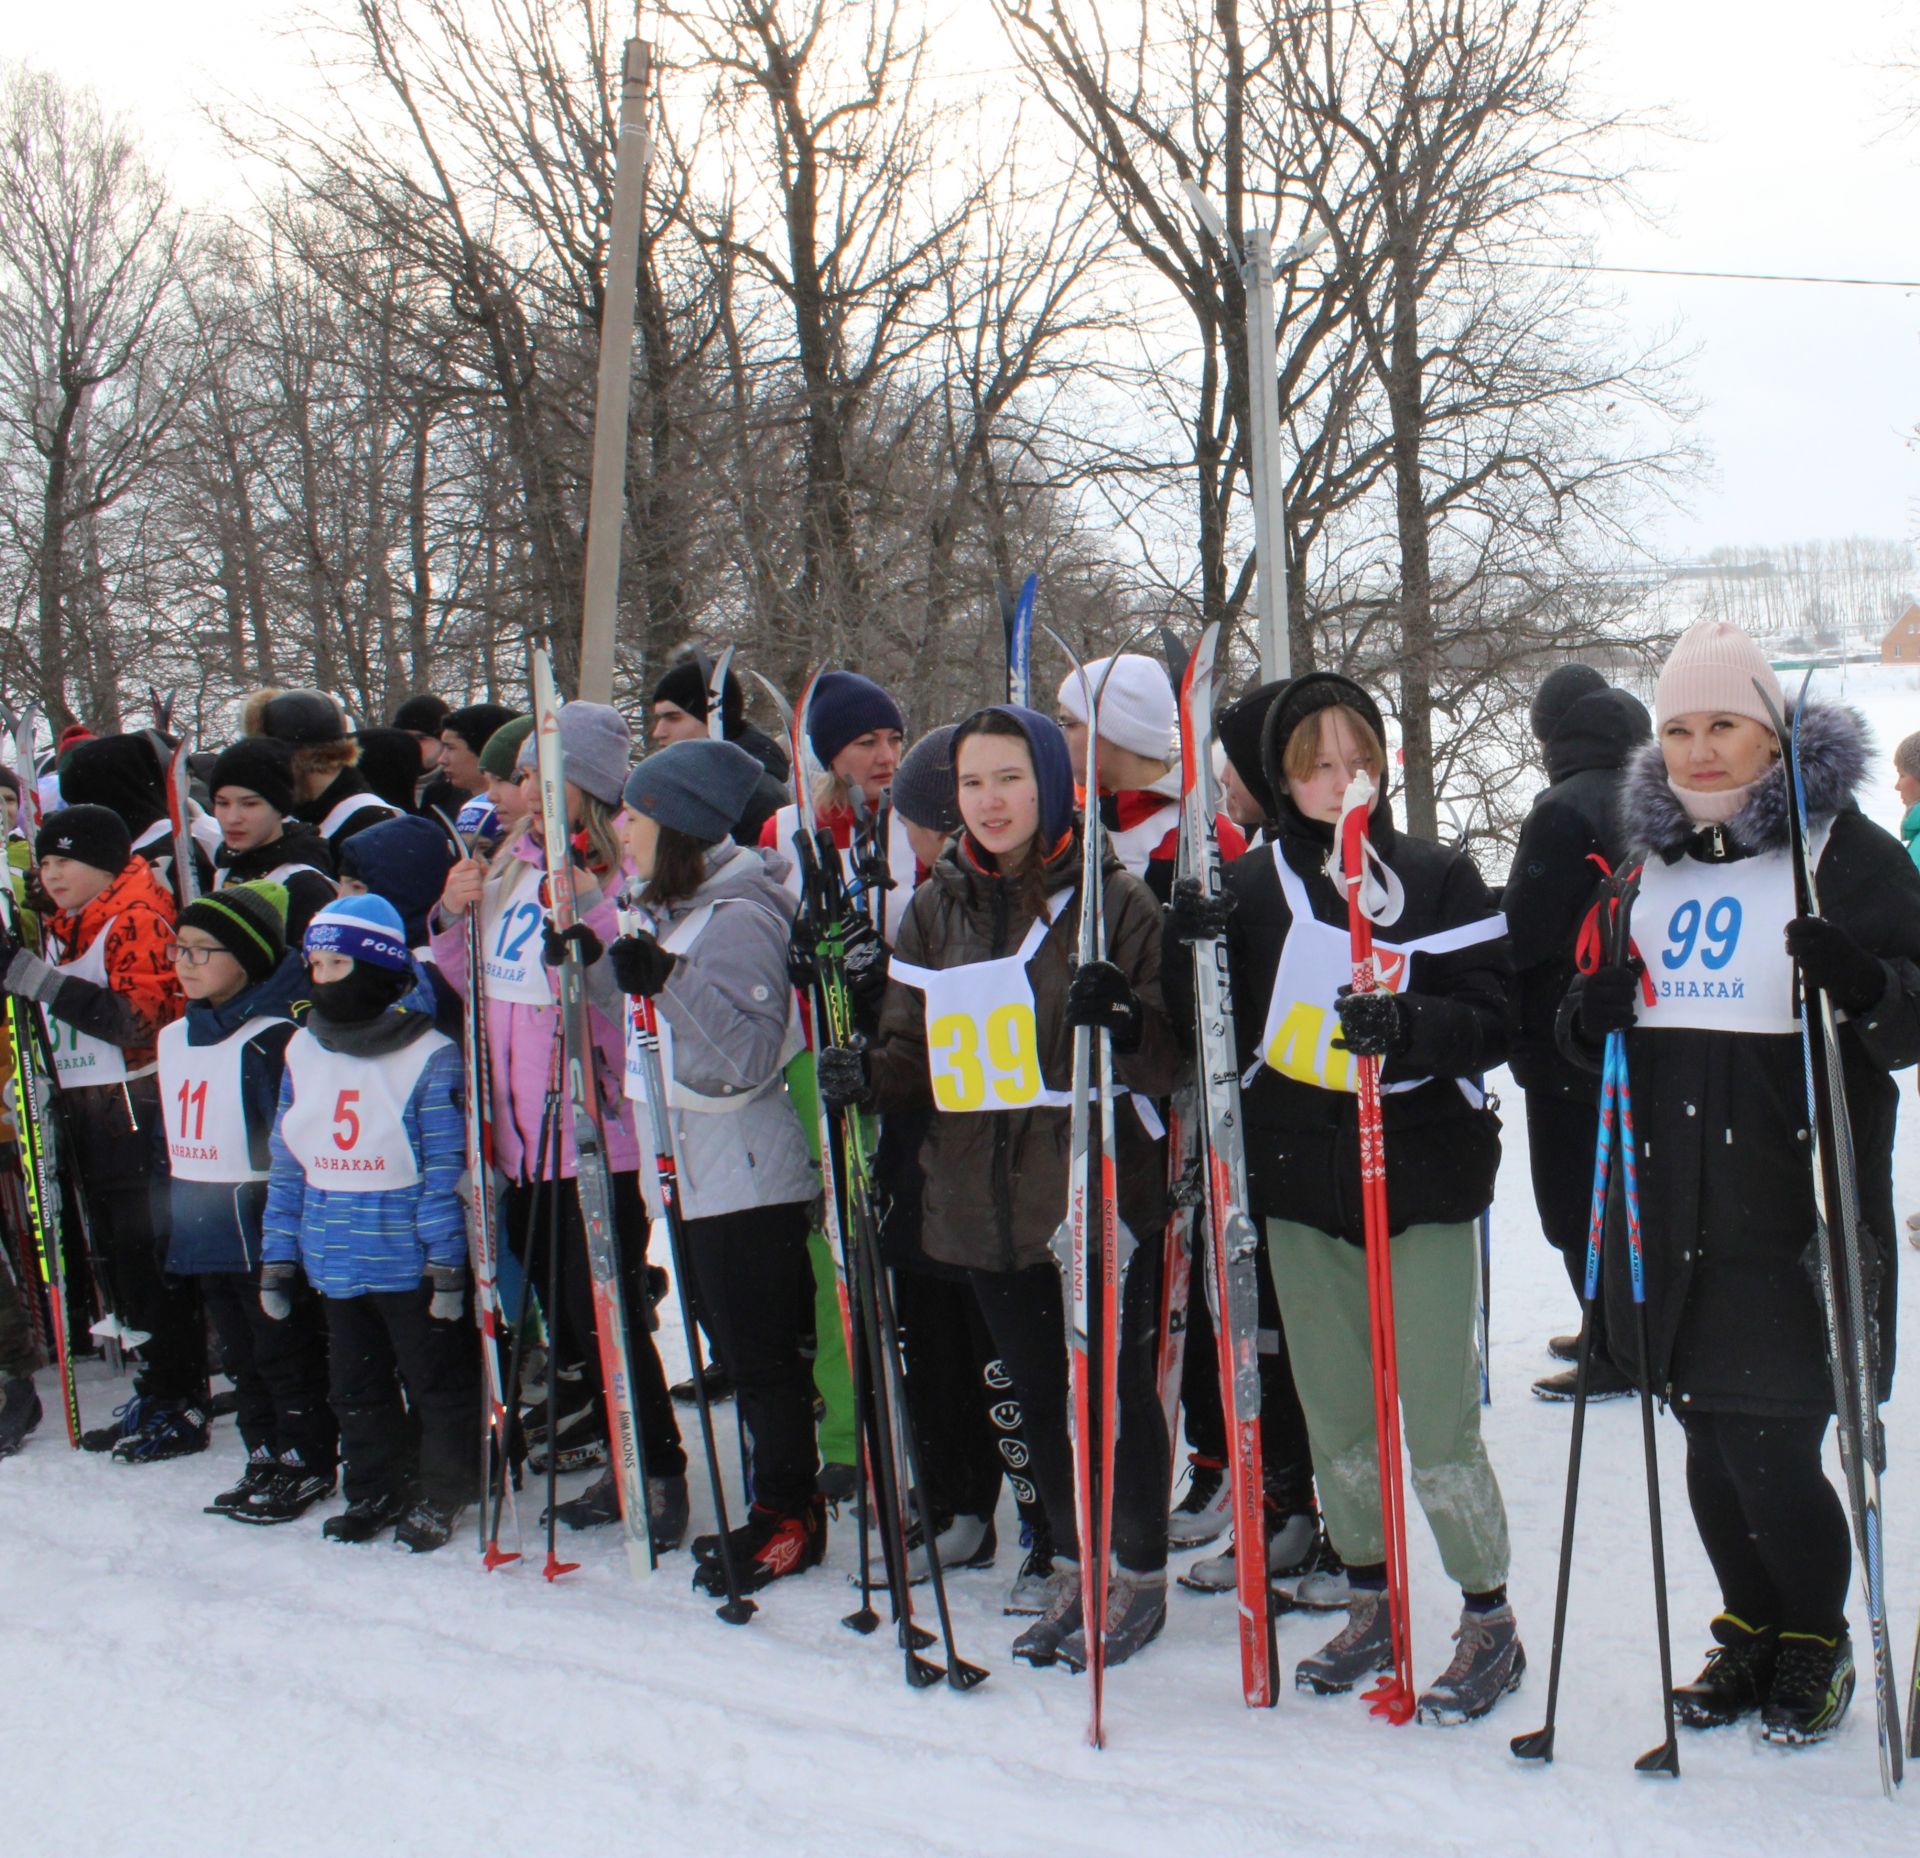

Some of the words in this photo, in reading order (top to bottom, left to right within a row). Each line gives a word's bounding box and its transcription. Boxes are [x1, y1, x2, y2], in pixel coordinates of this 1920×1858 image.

[495, 901, 541, 962] 12
[1205, 812, 1234, 1015] NODIK
[1662, 896, 1742, 970] 99
[931, 1003, 1041, 1110] 39
[178, 1079, 208, 1140] 11
[332, 1089, 360, 1151] 5
[314, 1156, 386, 1171] АЗНАКАЙ
[1073, 1184, 1084, 1302] UNIVERSAL
[1104, 1199, 1115, 1285] NORDIK
